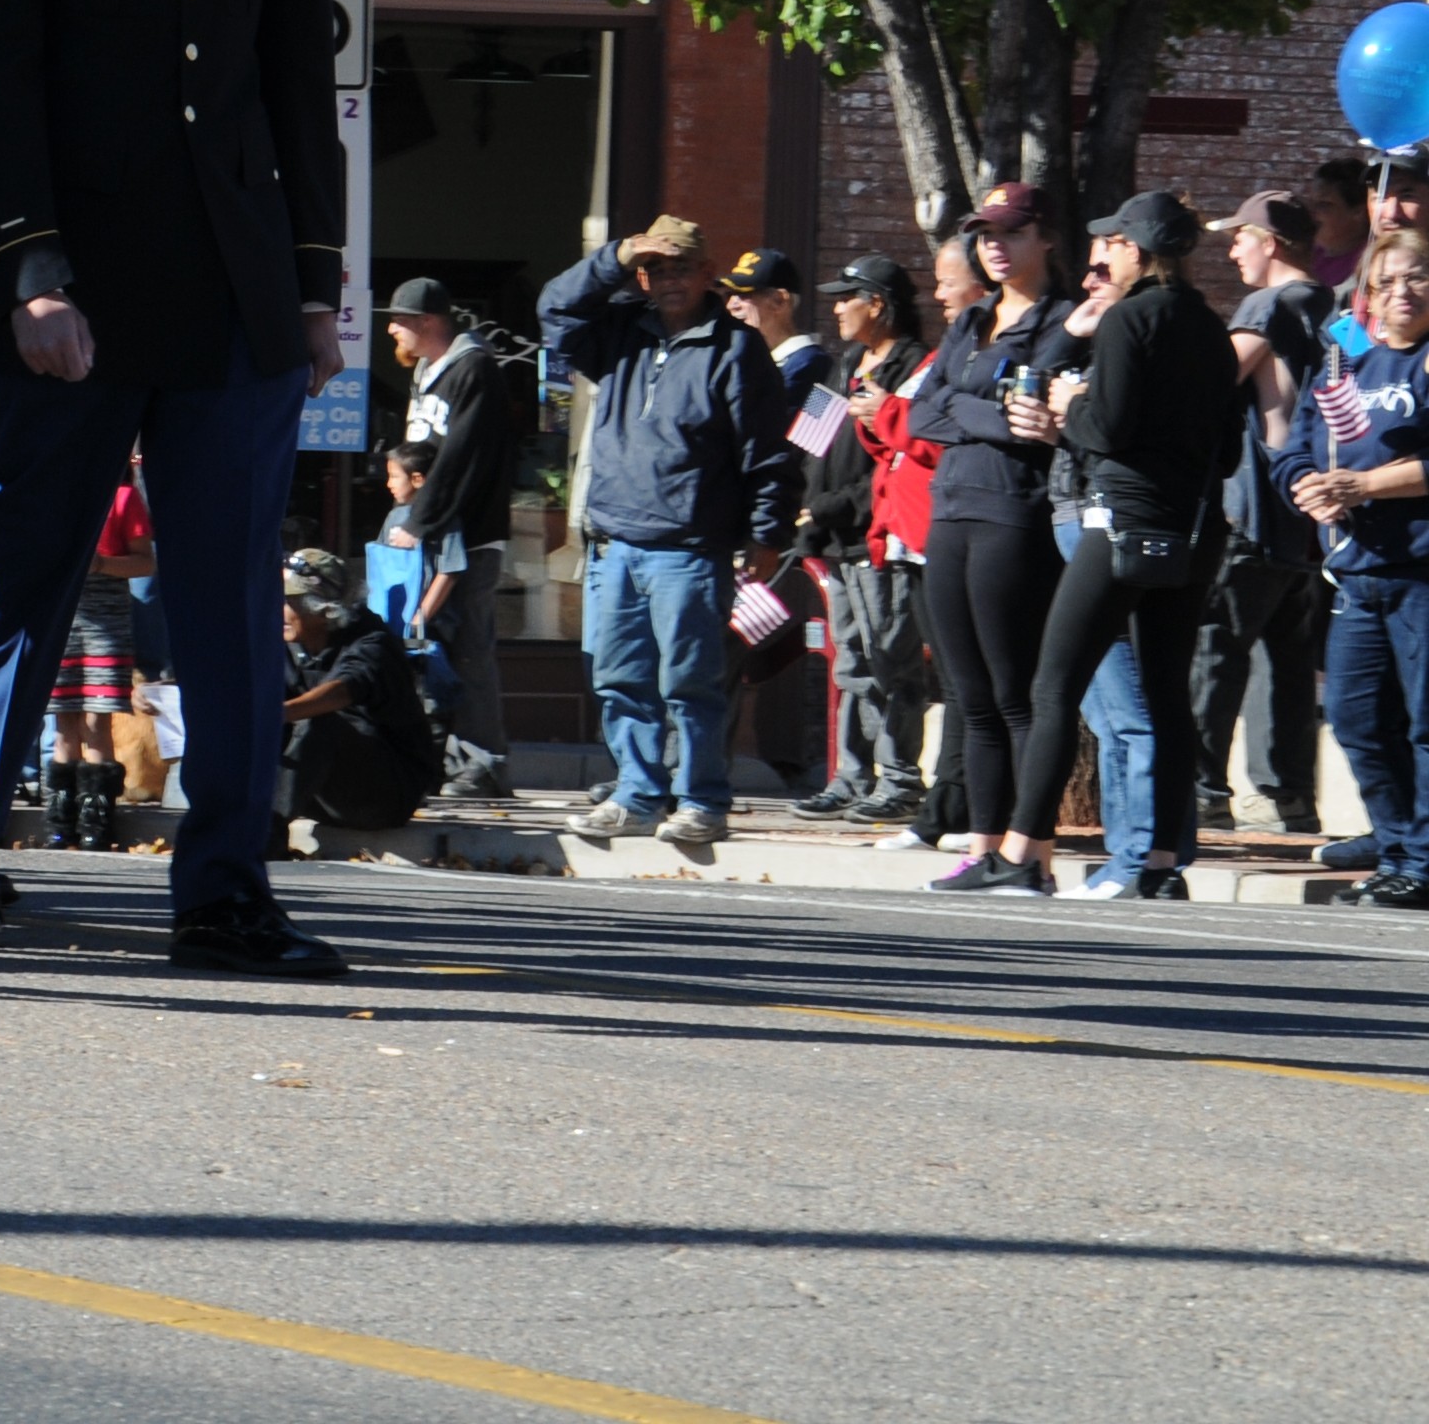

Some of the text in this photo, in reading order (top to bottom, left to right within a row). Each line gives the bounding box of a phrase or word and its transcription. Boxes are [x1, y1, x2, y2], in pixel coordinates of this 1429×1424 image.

[329, 407, 361, 423] On
[305, 428, 361, 445] & Off
